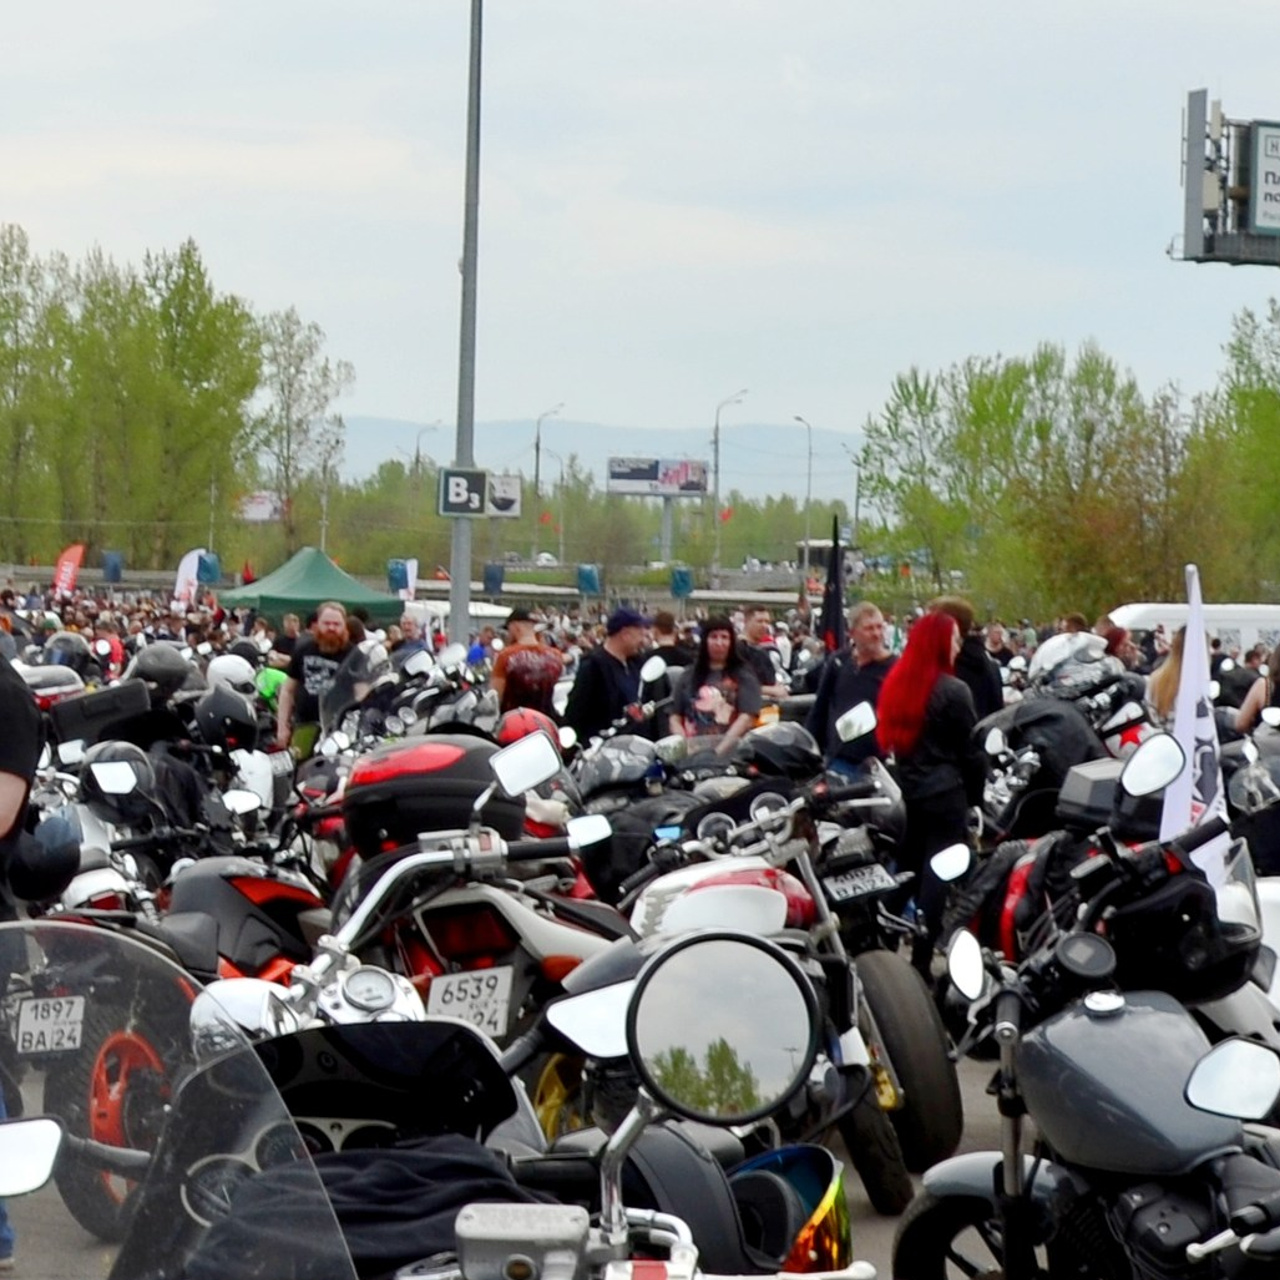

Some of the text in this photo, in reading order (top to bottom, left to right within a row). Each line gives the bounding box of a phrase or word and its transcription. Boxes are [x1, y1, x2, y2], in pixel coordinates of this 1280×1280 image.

[448, 476, 480, 509] B3
[440, 974, 499, 1005] 6539
[30, 1000, 75, 1020] 1897
[21, 1026, 77, 1050] BA 24
